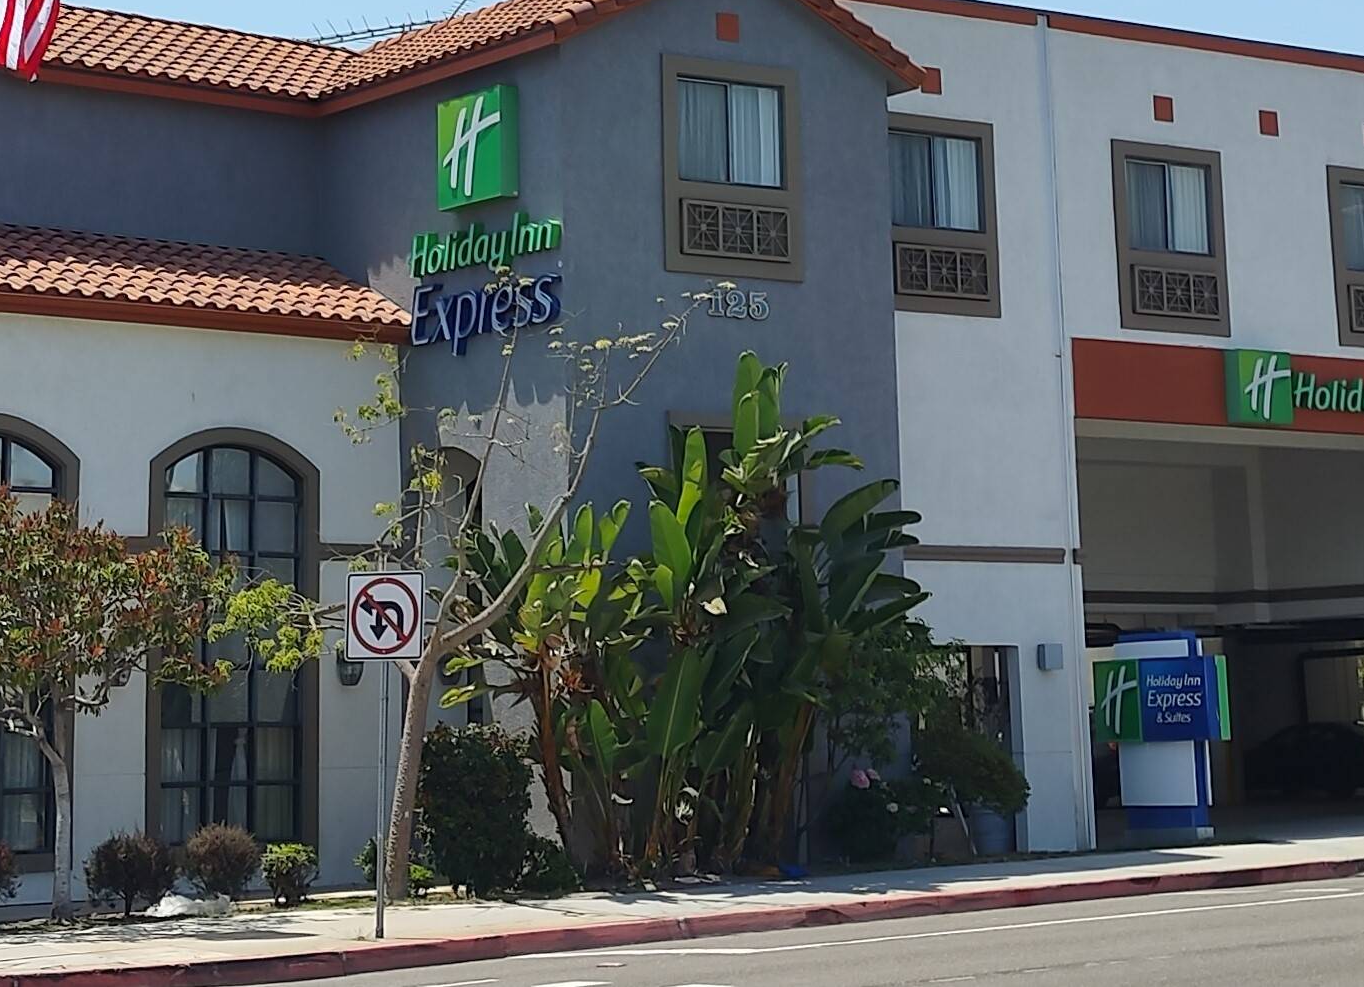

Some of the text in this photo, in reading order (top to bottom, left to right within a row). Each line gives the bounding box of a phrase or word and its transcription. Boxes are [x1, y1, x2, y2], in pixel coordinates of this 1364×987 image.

[409, 211, 563, 278] Holiday Inn
[411, 271, 563, 357] Express
[707, 289, 770, 321] 125
[1146, 674, 1201, 690] Holiday Inn
[1147, 689, 1203, 712] Express
[1156, 713, 1192, 724] & Suites
